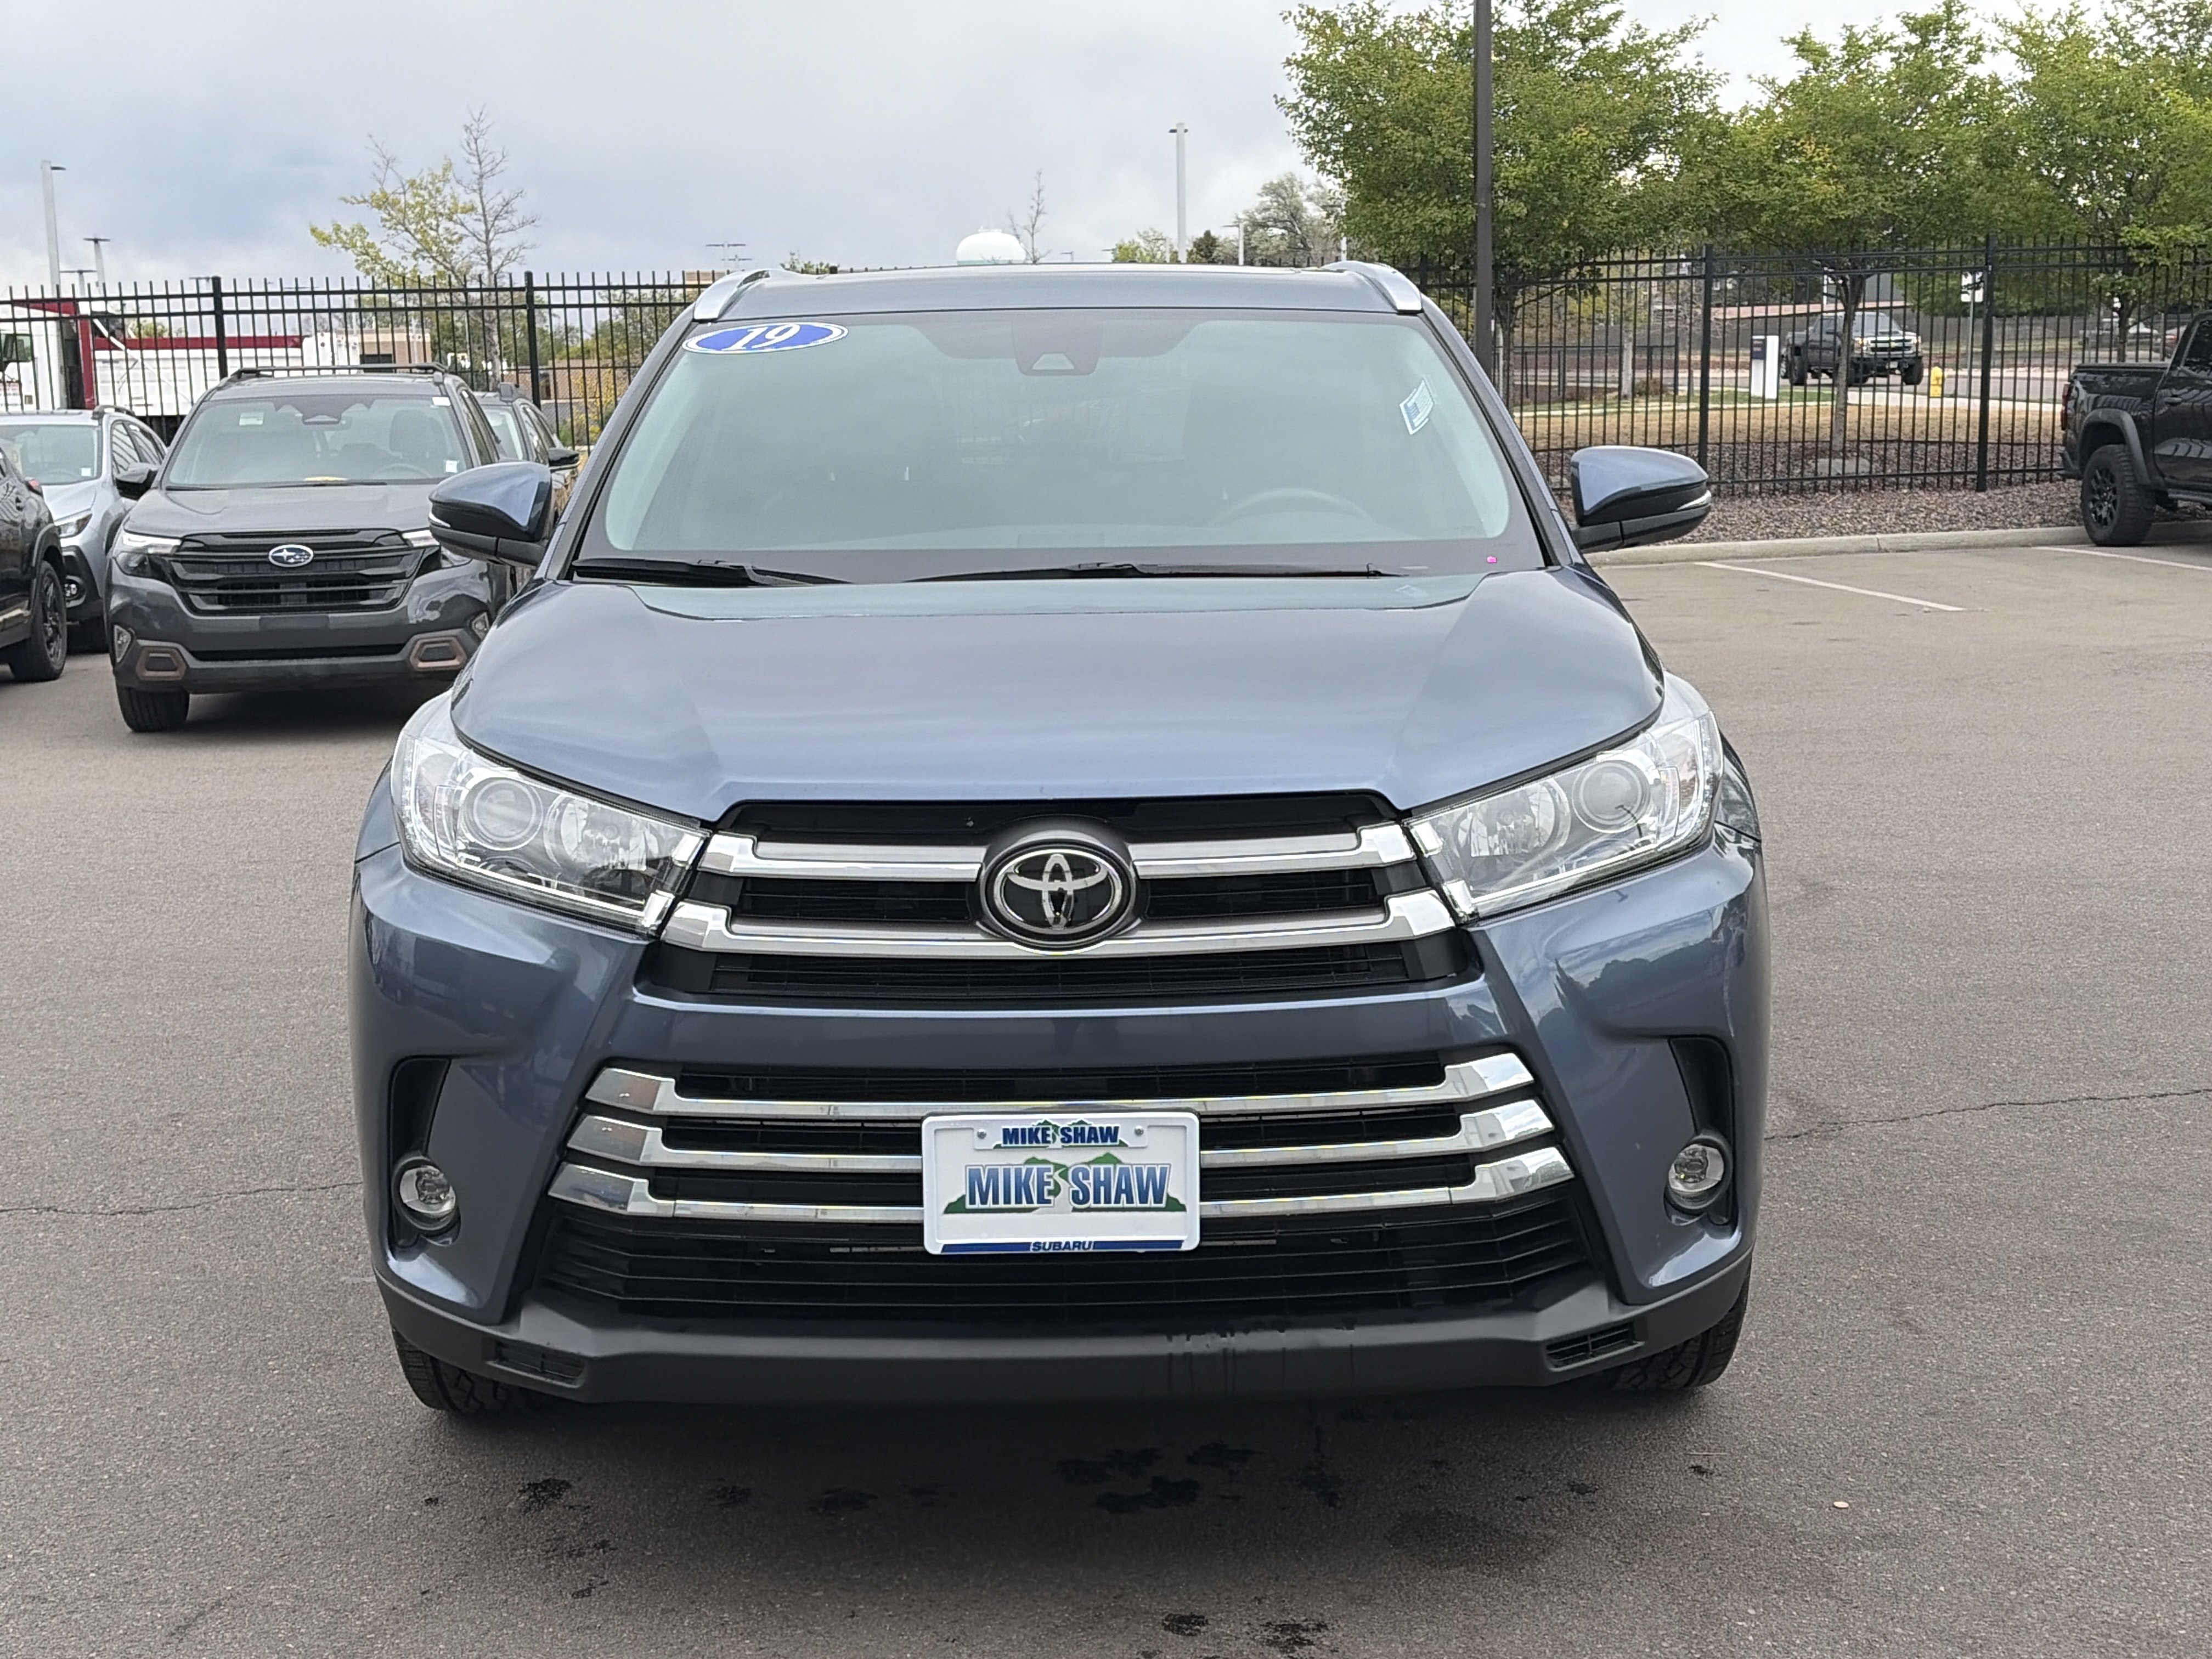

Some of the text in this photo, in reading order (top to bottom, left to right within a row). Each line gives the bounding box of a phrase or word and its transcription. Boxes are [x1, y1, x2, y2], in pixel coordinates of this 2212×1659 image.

[721, 324, 802, 351] 19
[1002, 1126, 1119, 1144] MIKE SHAW
[968, 1166, 1168, 1205] MIKE SHAW
[1031, 1240, 1092, 1251] SUBARU
